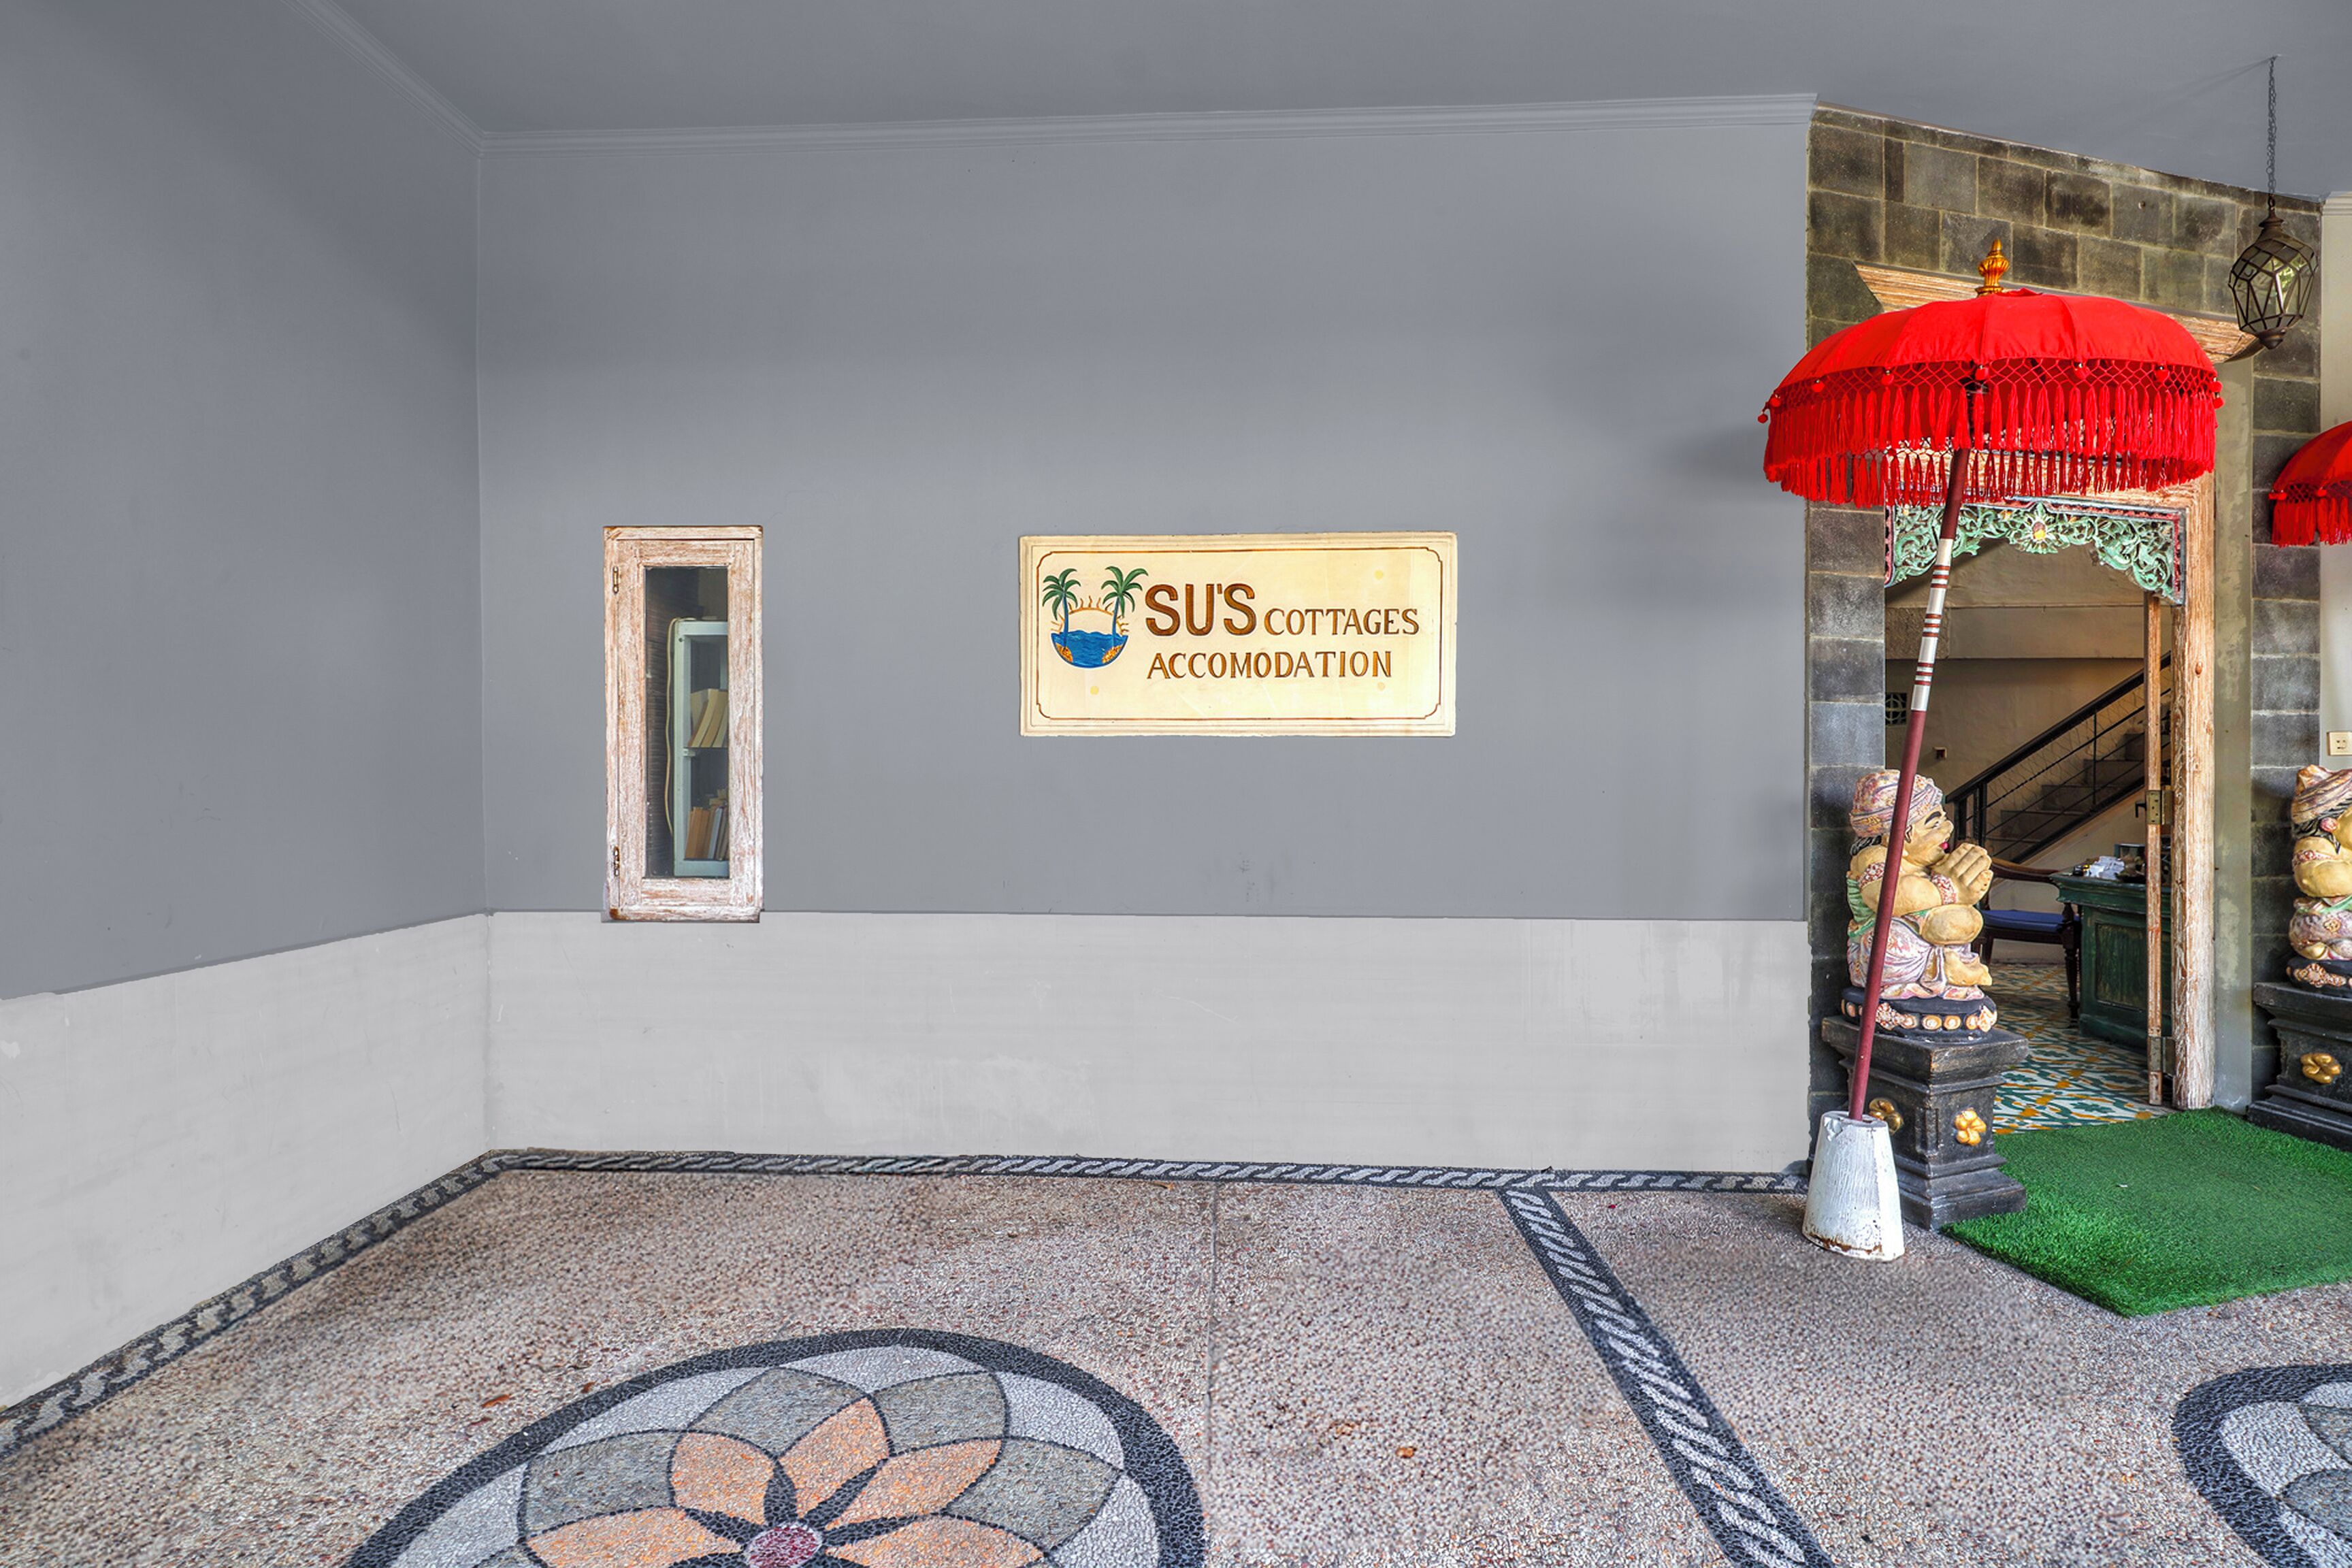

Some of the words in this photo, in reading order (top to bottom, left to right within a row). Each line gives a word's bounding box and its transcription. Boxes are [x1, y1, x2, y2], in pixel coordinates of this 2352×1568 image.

[1145, 583, 1257, 636] SU'S
[1264, 608, 1420, 636] COTTAGES
[1147, 651, 1392, 679] ACCOMODATION
